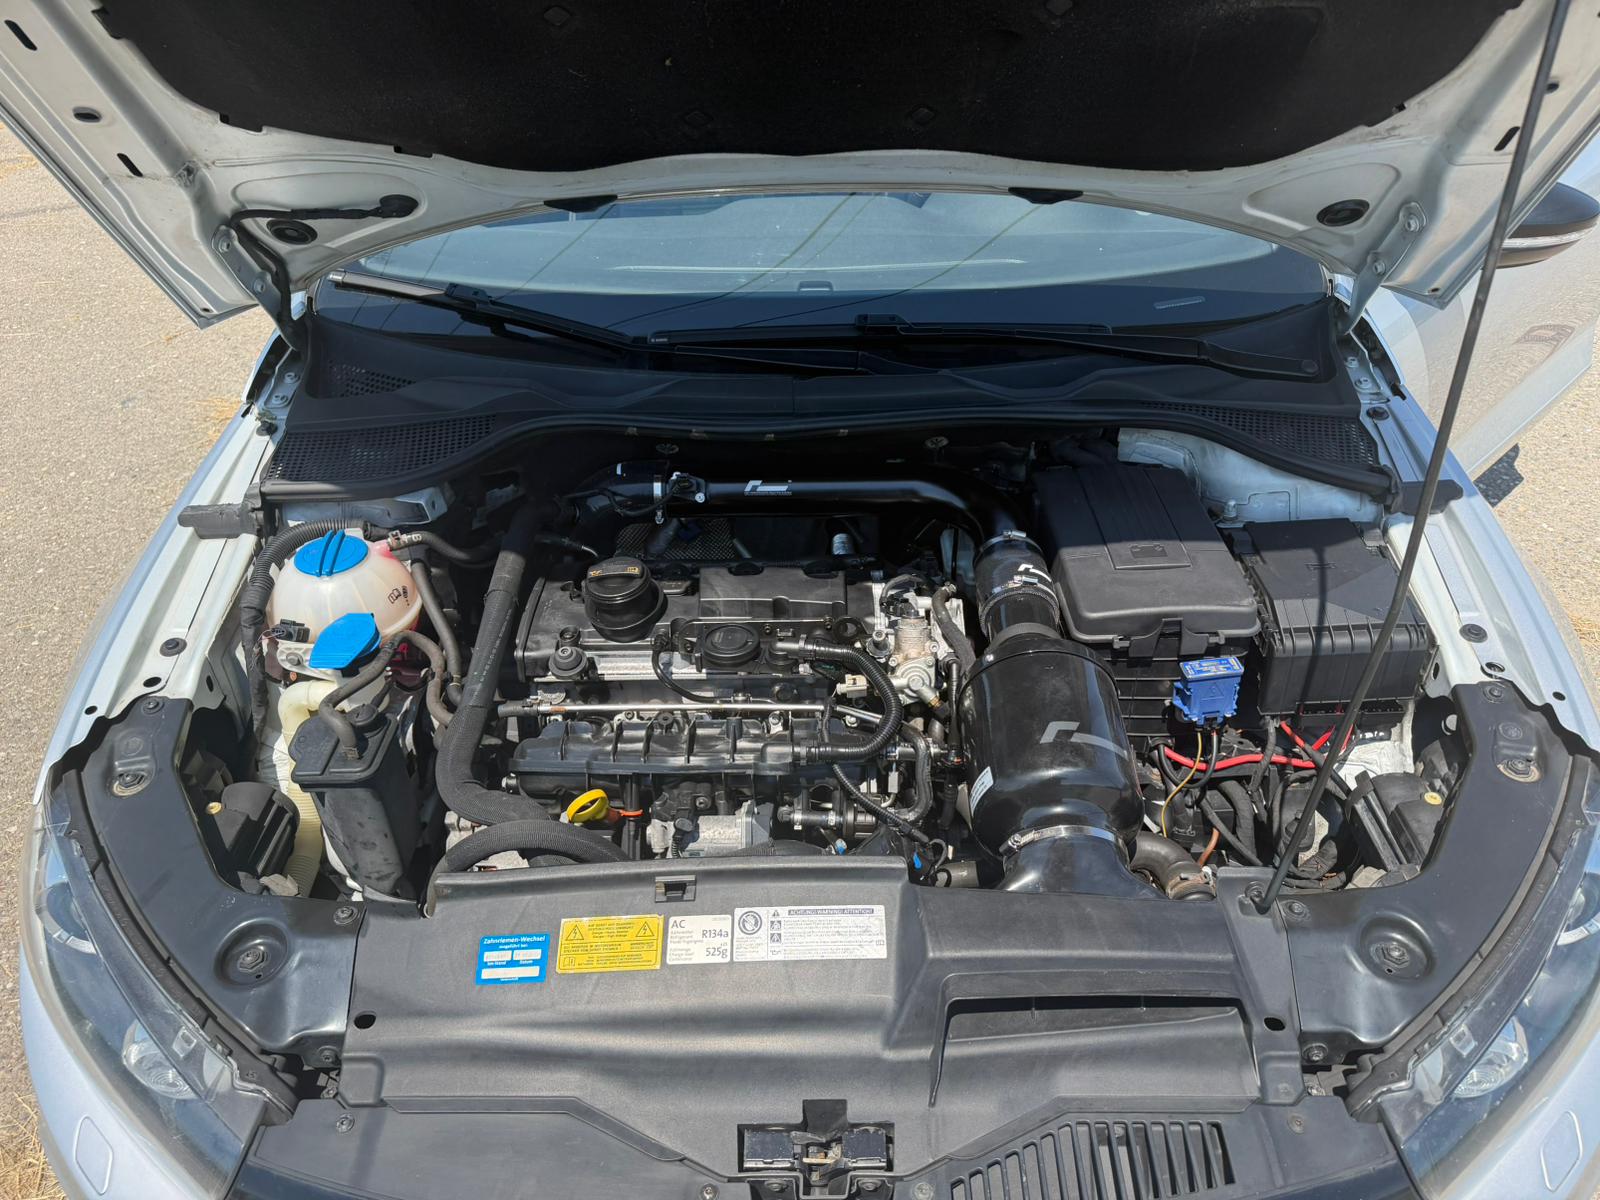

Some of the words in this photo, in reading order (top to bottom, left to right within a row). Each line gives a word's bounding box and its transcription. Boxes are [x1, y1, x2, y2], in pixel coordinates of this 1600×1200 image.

[671, 920, 686, 928] AC
[701, 929, 729, 938] R134a
[705, 947, 728, 959] 525g
